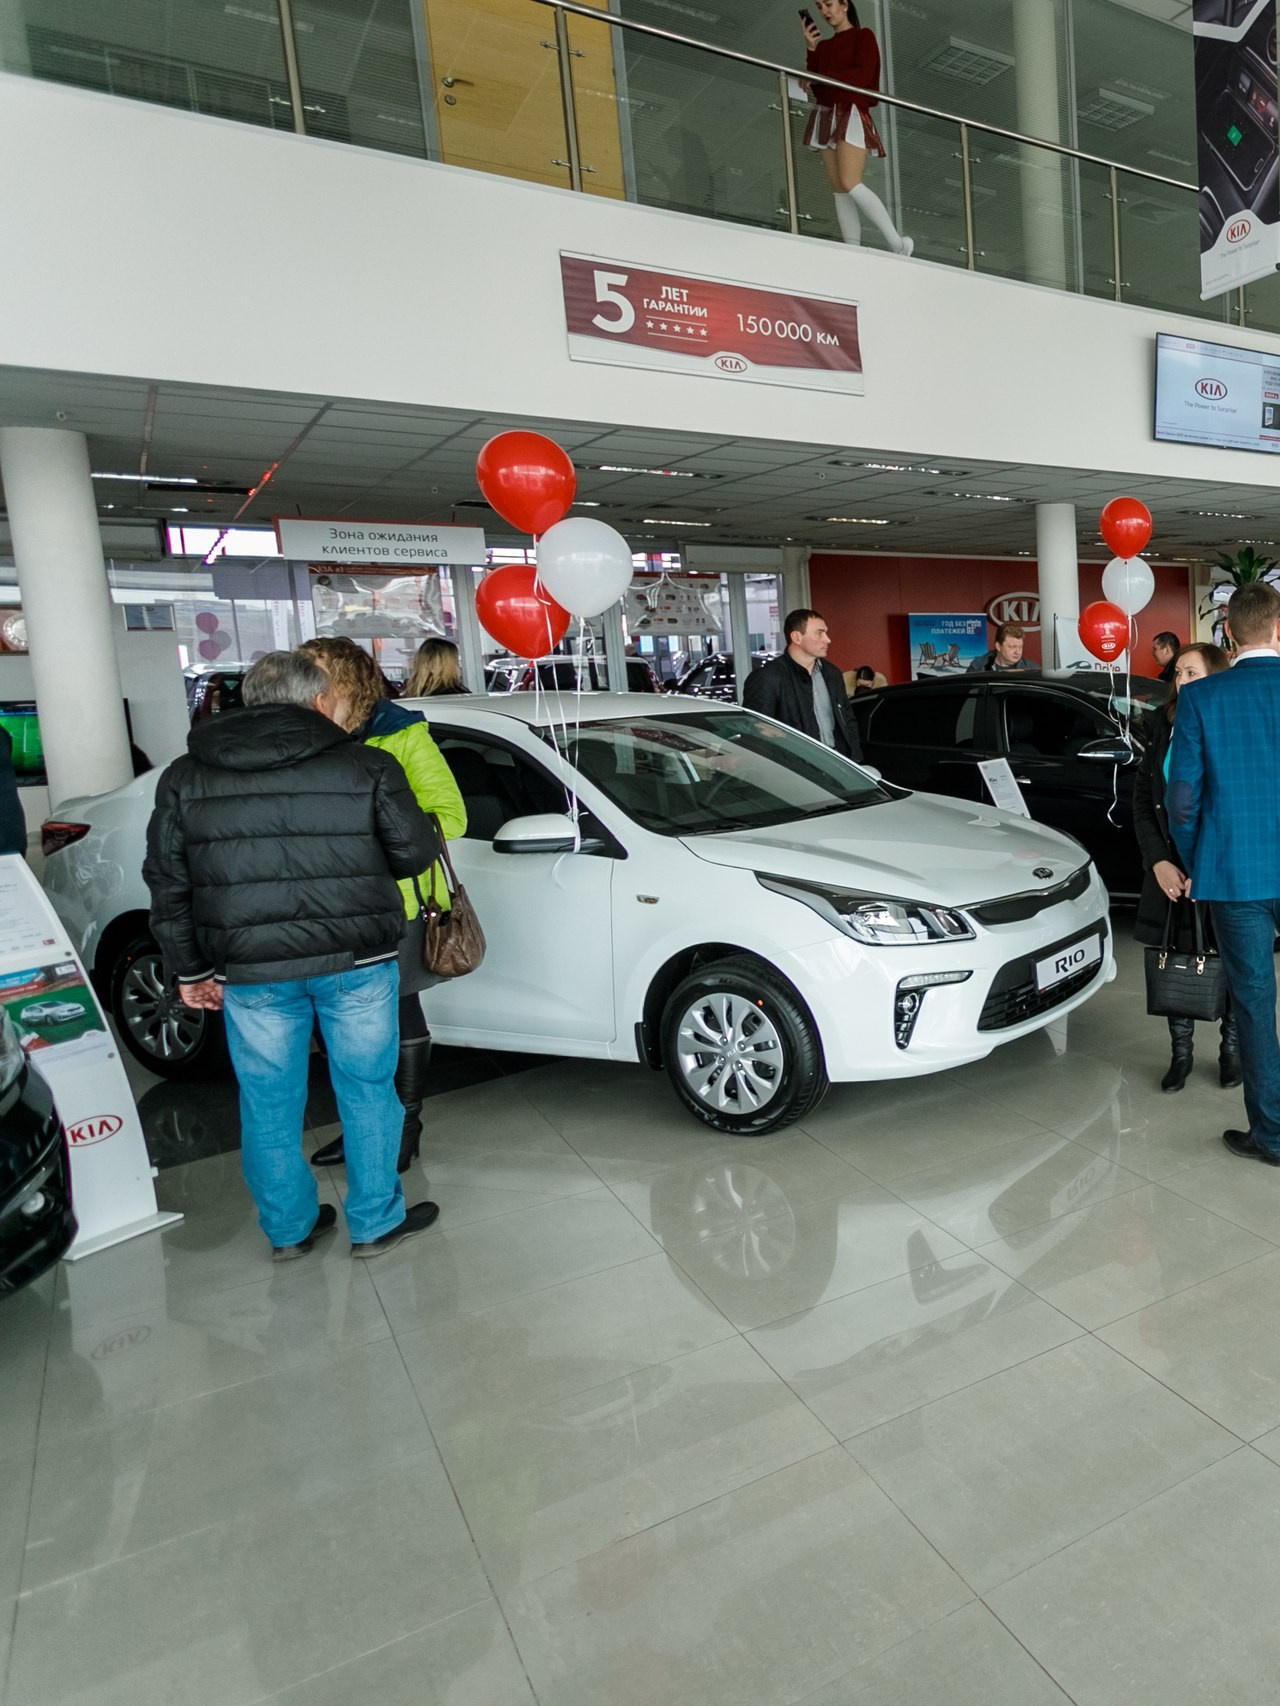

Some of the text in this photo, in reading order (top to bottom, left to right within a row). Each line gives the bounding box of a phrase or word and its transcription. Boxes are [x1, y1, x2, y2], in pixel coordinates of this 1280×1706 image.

[1230, 223, 1247, 240] KIA
[592, 270, 689, 333] 5 ЛЕТ
[643, 298, 708, 318] ГАРАНТИИ
[736, 313, 772, 336] 150
[774, 319, 812, 343] 000
[719, 358, 743, 371] KIA
[1200, 382, 1222, 397] KIA
[1184, 400, 1194, 409] The
[1194, 402, 1210, 411] Power
[329, 528, 439, 543] Зона ожидания
[322, 545, 448, 559] клиентов сервиса
[1055, 949, 1085, 974] RIO
[70, 1119, 114, 1144] KIA
